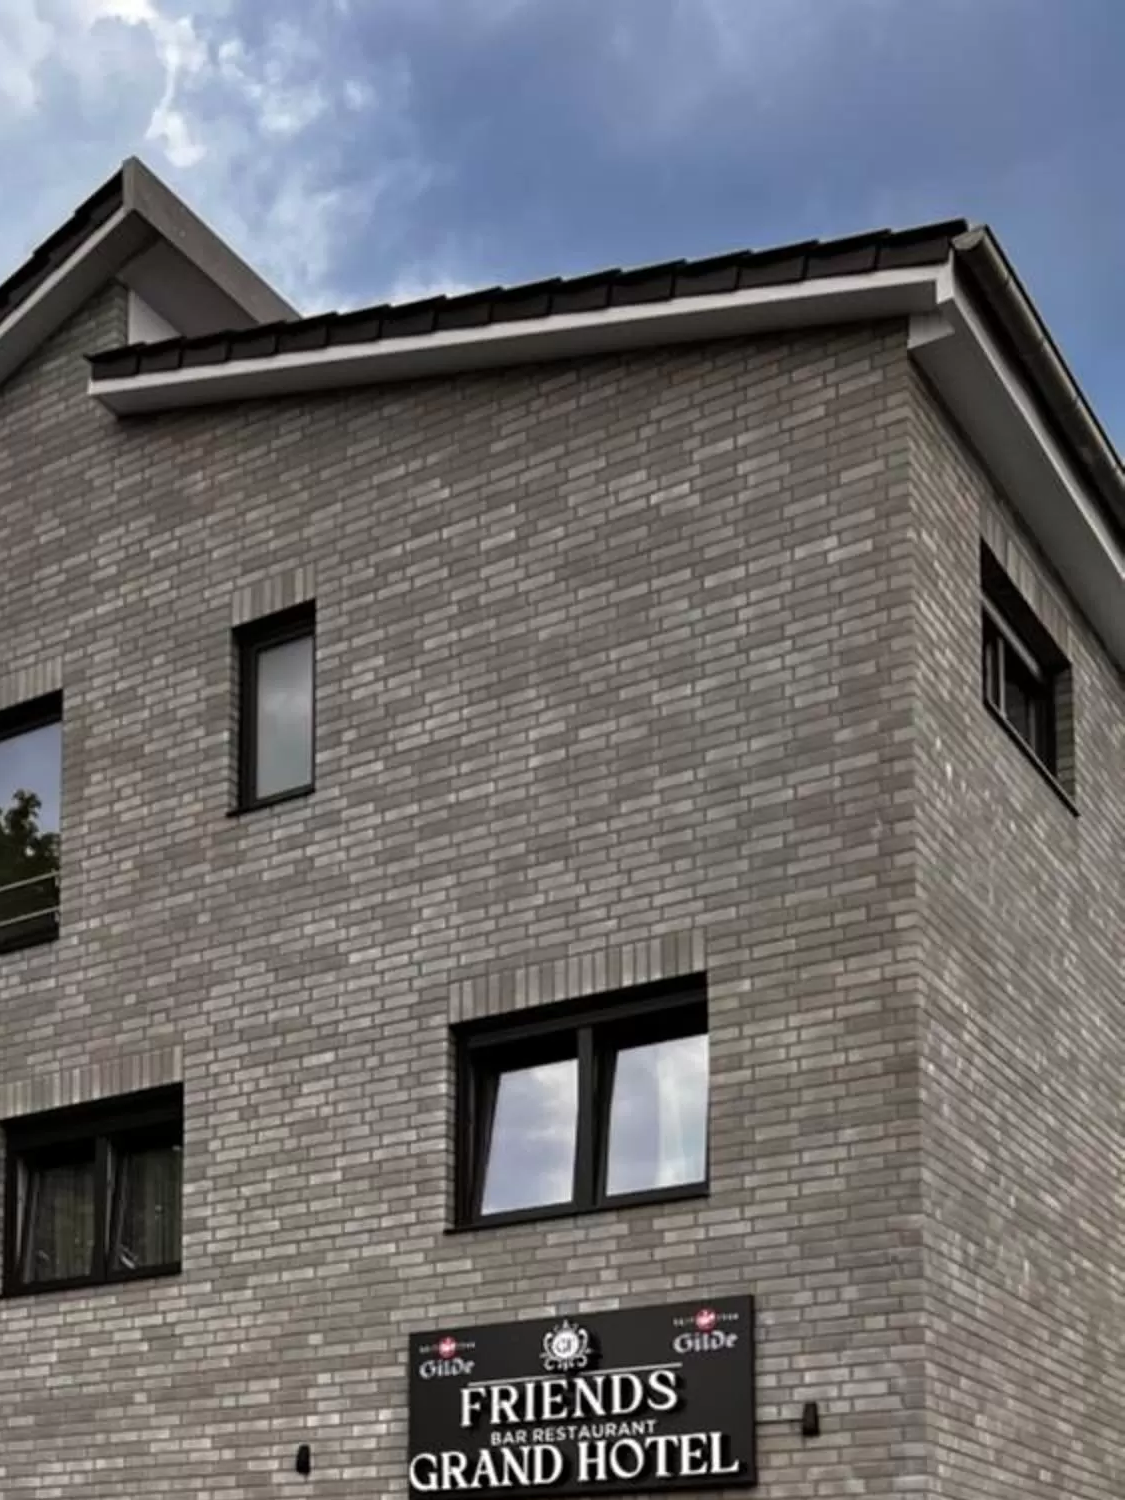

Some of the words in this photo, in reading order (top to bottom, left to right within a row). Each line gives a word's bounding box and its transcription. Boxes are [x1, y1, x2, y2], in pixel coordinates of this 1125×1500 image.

[673, 1330, 739, 1353] Gilde
[460, 1371, 677, 1427] FRIENDS
[490, 1428, 527, 1446] BAR
[533, 1419, 657, 1443] RESTAURANT
[409, 1445, 563, 1491] GRAND
[577, 1431, 739, 1482] HOTEL
